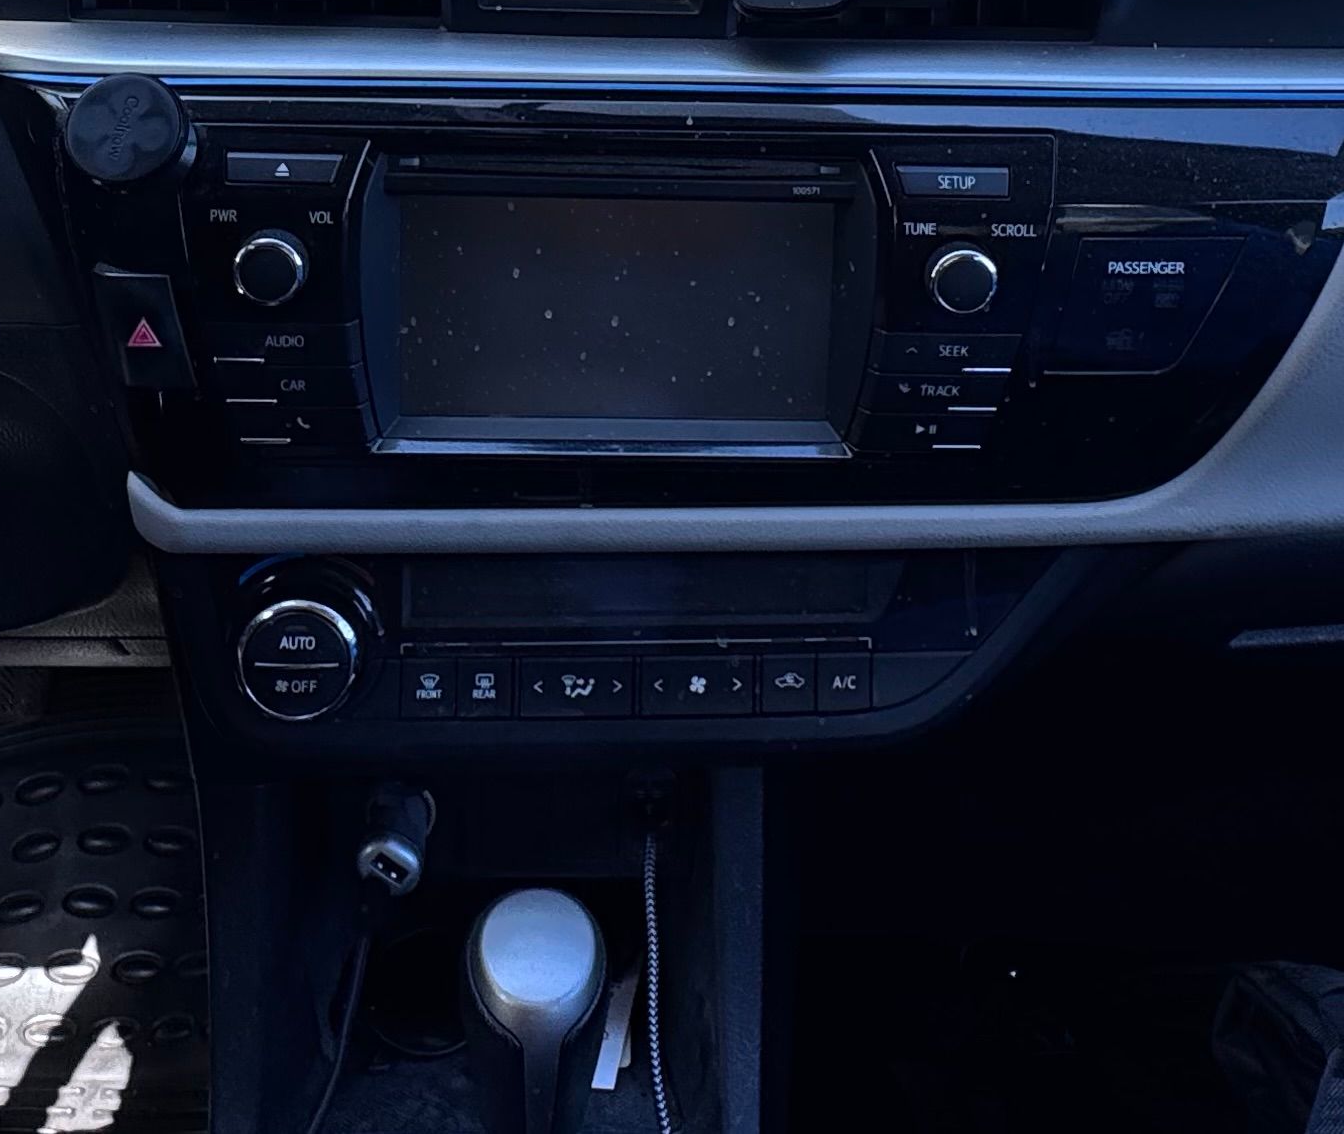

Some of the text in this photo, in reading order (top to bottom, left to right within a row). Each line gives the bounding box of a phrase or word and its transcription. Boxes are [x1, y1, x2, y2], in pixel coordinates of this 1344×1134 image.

[937, 175, 976, 190] SETUP
[209, 208, 238, 223] PWR
[308, 210, 334, 225] VOL
[903, 221, 937, 236] TUNE
[991, 223, 1038, 237] SCROLL
[1107, 260, 1185, 275] PASSENGER
[264, 335, 305, 348] AUDIO
[938, 344, 969, 358] SEEK
[279, 378, 306, 392] CAR
[919, 384, 961, 397] TRACK
[278, 636, 316, 651] AUTO
[290, 680, 319, 694] OFF
[832, 674, 857, 690] A/C
[415, 689, 443, 699] FRONT
[472, 689, 497, 699] REAR
